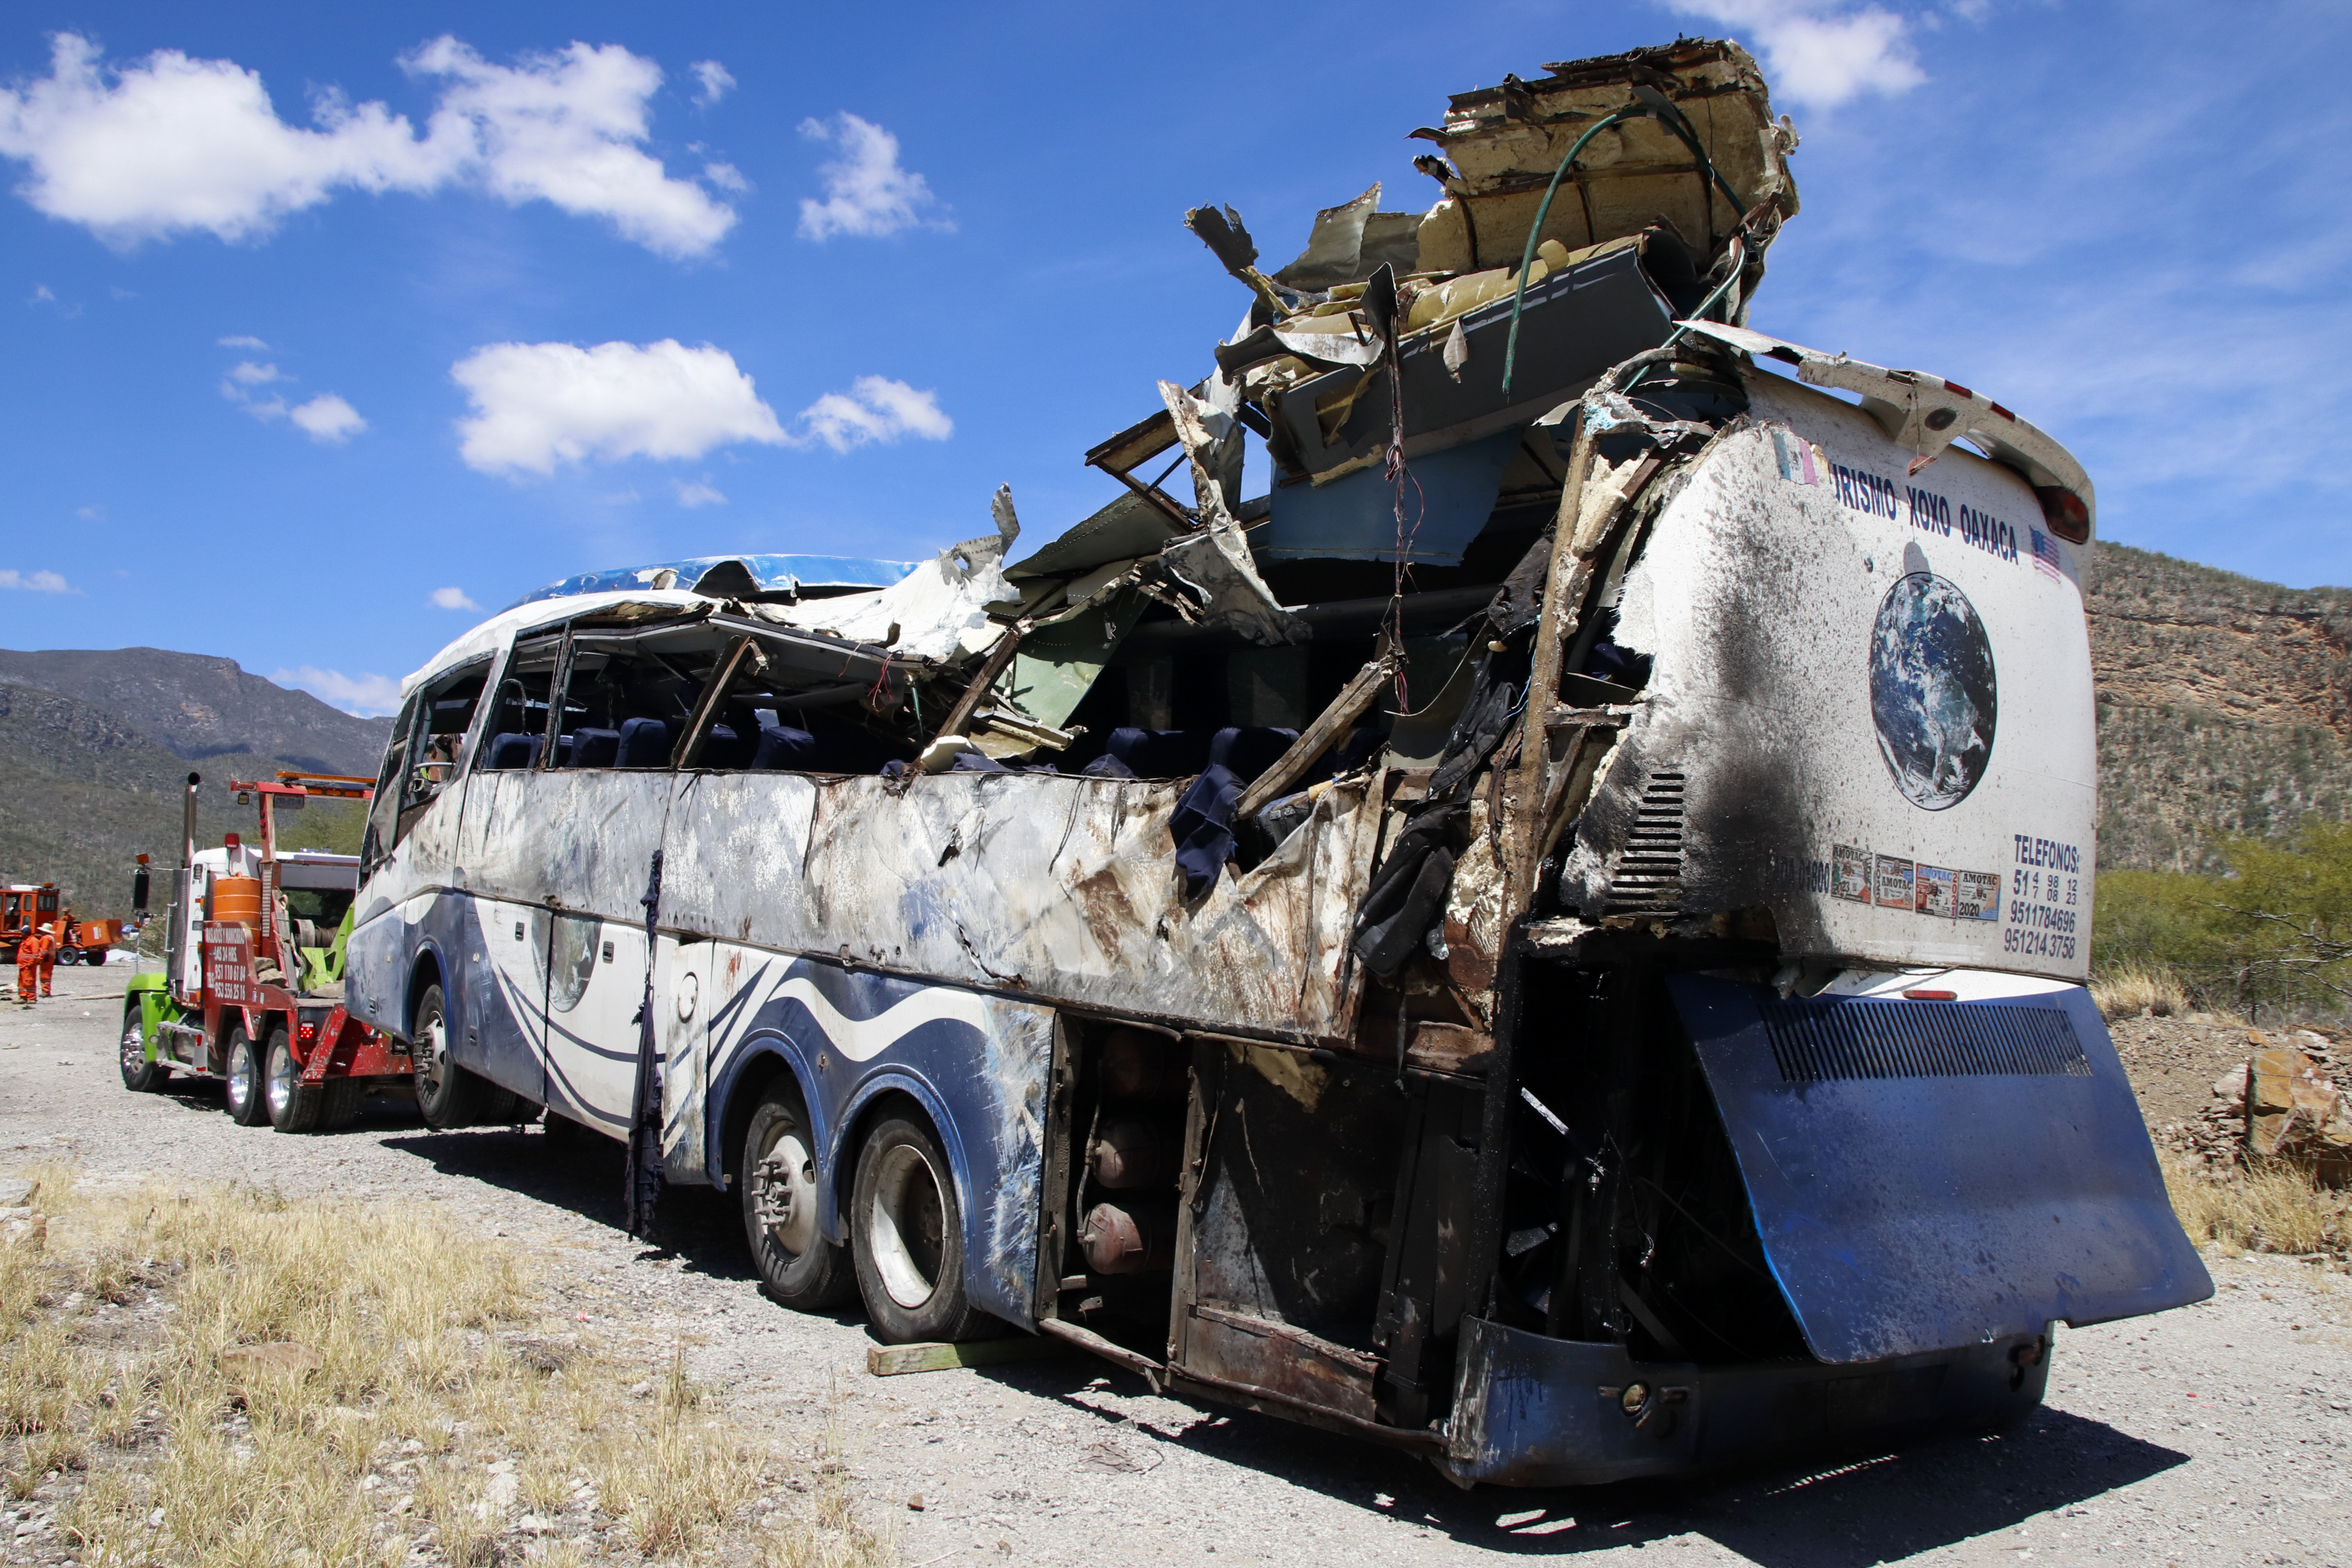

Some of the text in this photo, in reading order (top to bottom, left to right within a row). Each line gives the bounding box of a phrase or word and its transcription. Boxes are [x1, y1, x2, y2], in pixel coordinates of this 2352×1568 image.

[1905, 484, 1951, 538] XOXO
[1959, 503, 2019, 566] OAXACA
[1833, 846, 1864, 862] AMOTAC
[2015, 834, 2080, 874] TELEFONOS:
[1881, 876, 1912, 891] AMOTAC
[1918, 866, 1953, 882] AMOTAC
[1962, 873, 1998, 886] AMOTAC
[2013, 869, 2078, 896] 51 4 98 12
[2032, 886, 2077, 906] 7 08 23
[1958, 901, 1980, 917] 2020
[2010, 899, 2076, 933] 9511784696
[222, 946, 228, 962] 24
[214, 963, 246, 982] 951 110 61 84
[214, 982, 246, 1001] 953 556 25 16
